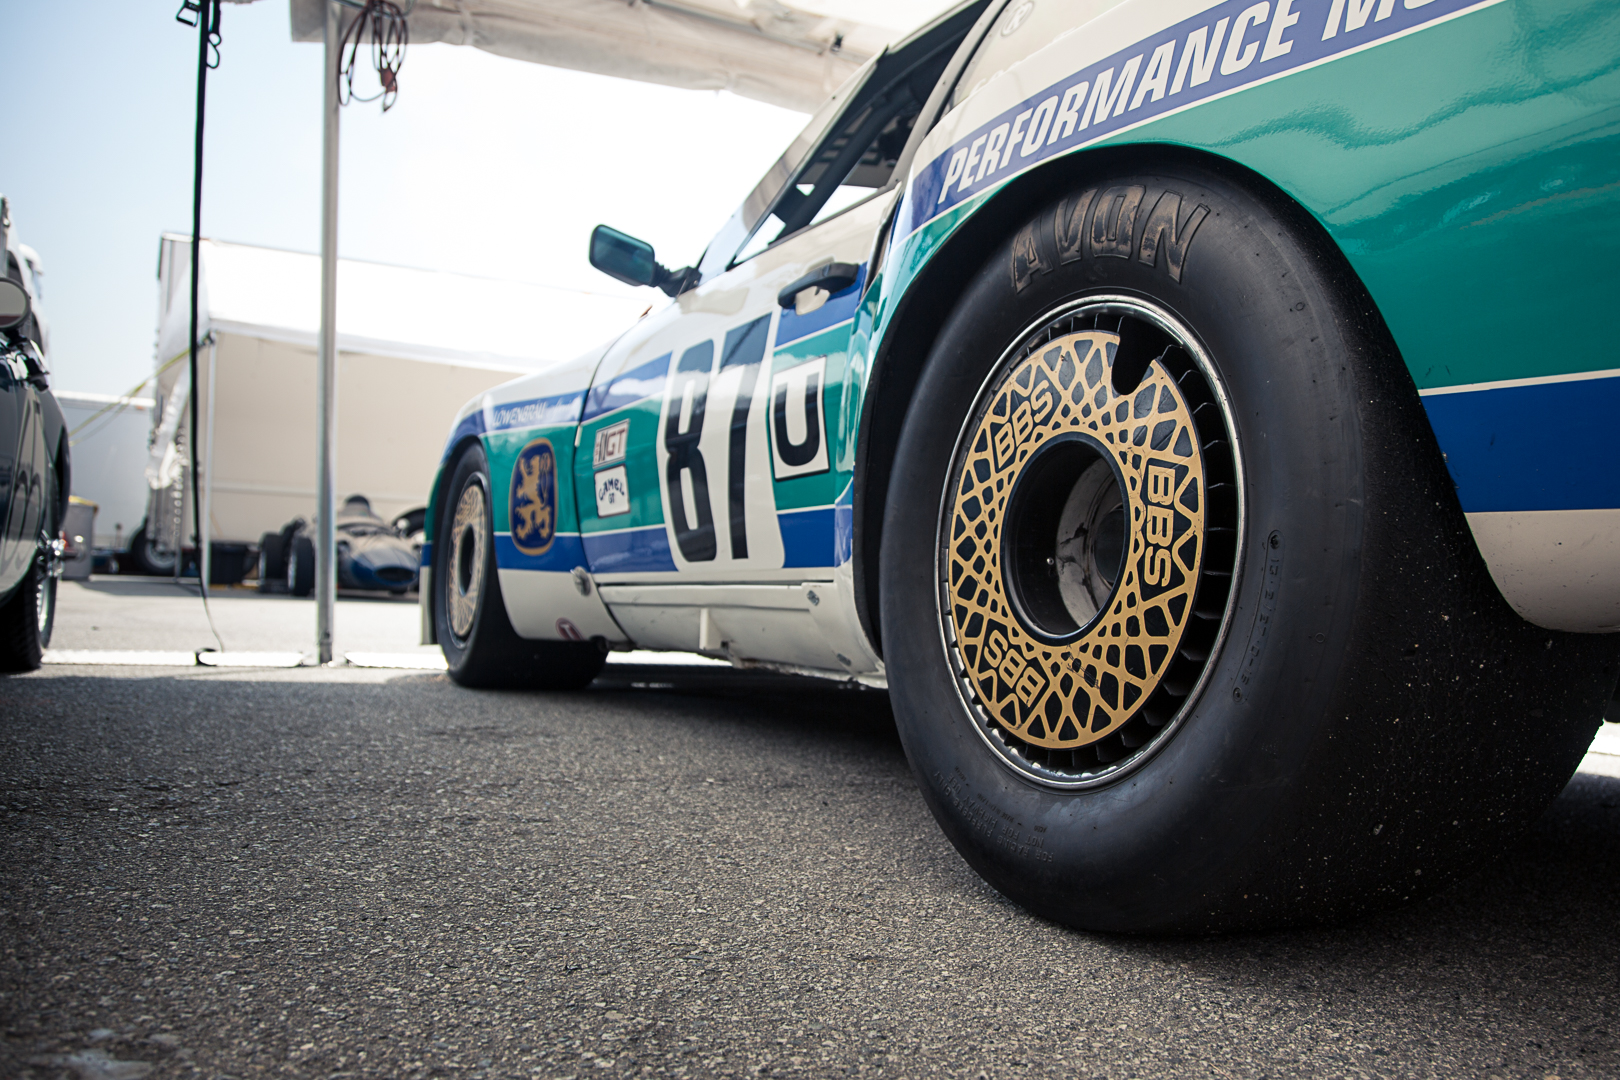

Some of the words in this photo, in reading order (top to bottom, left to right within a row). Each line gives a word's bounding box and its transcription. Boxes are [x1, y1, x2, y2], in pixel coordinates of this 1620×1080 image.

[937, 0, 1301, 205] PERFORMANCE
[1011, 184, 1212, 294] AVON
[664, 311, 773, 563] 87
[774, 371, 820, 467] U
[994, 379, 1053, 469] BBS
[599, 477, 625, 501] CAMEL
[1143, 464, 1176, 587] BBS
[984, 629, 1046, 708] BBS
